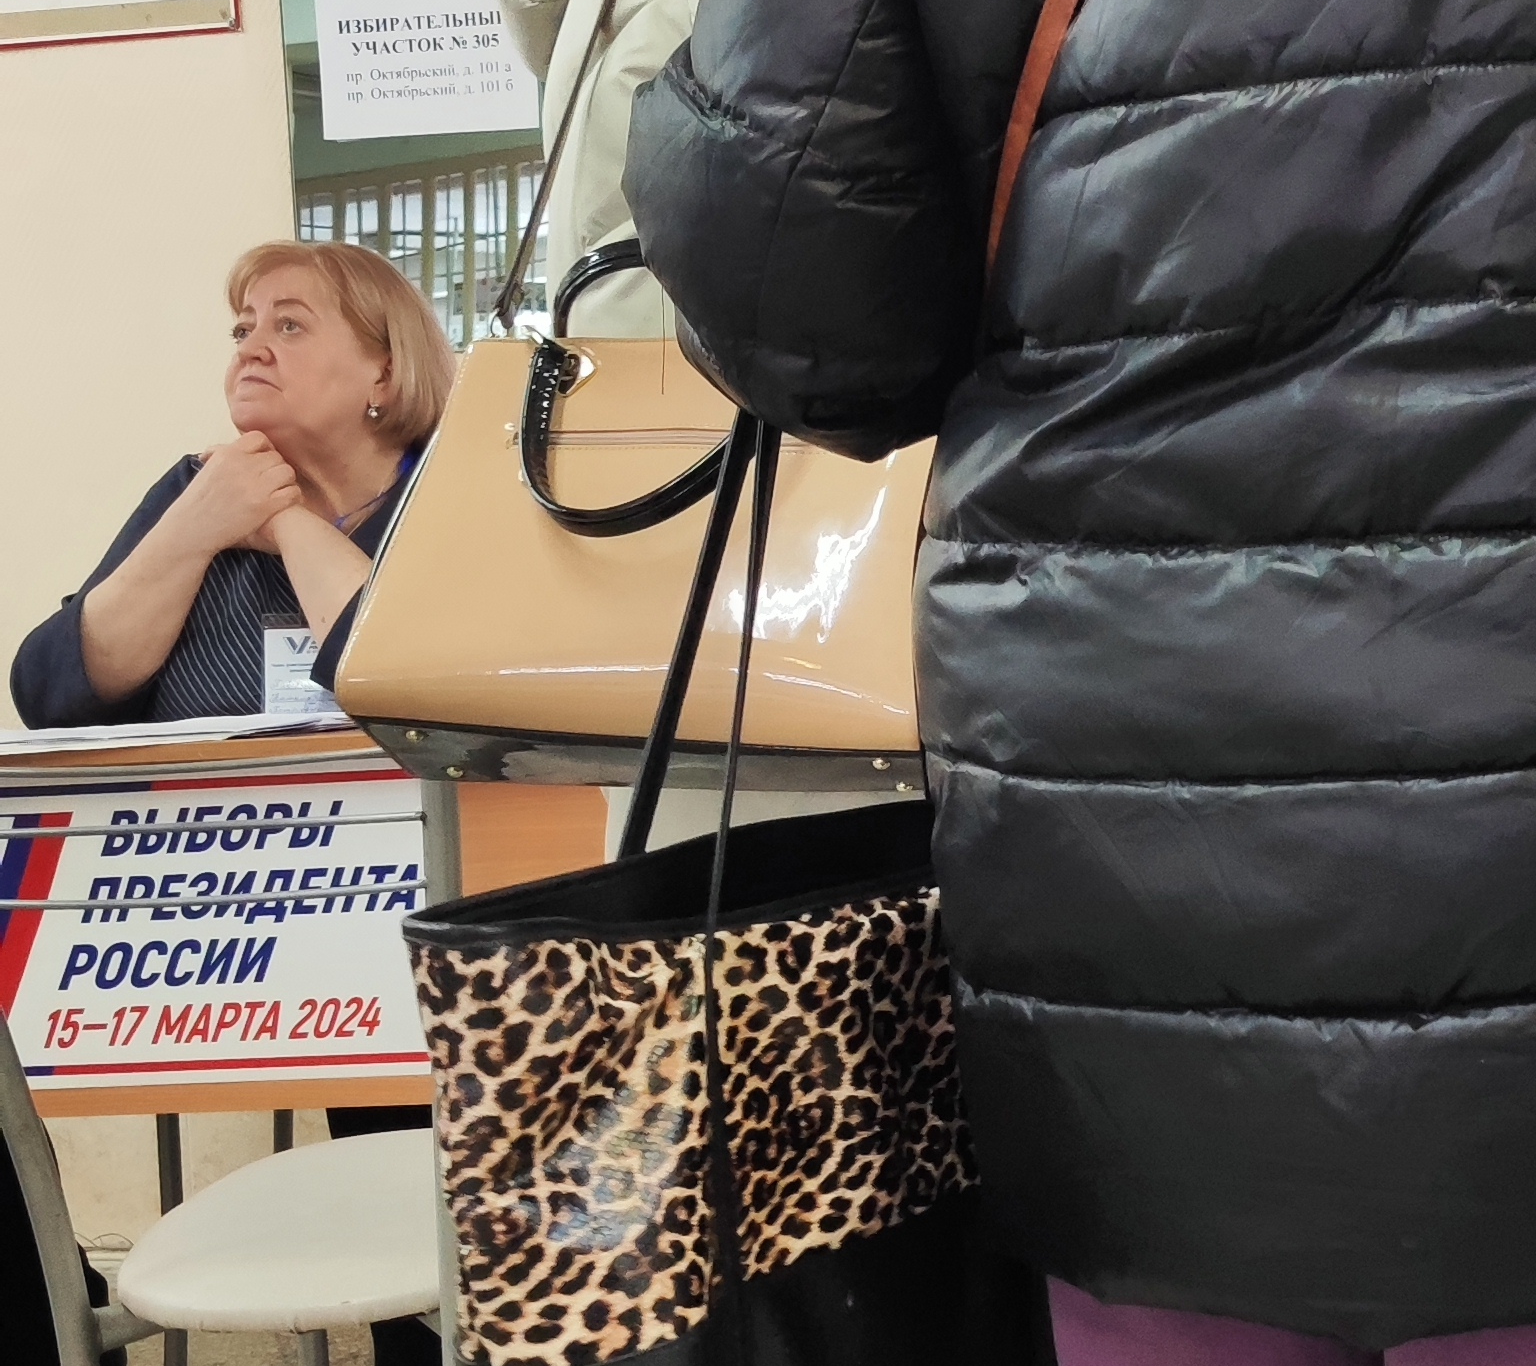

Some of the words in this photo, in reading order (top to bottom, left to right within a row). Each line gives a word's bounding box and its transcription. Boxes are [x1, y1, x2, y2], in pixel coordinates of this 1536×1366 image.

[351, 37, 445, 56] УЧАСТОК
[449, 35, 468, 50] №
[472, 33, 500, 49] 305
[479, 61, 500, 73] 101
[480, 80, 500, 93] 101
[100, 800, 344, 857] ВЫБОРЫ
[80, 863, 419, 925] ПРЕЗИДЕНТА
[57, 936, 278, 992] РОССИИ
[151, 1000, 282, 1045] МАРТА
[287, 996, 382, 1040] 2024
